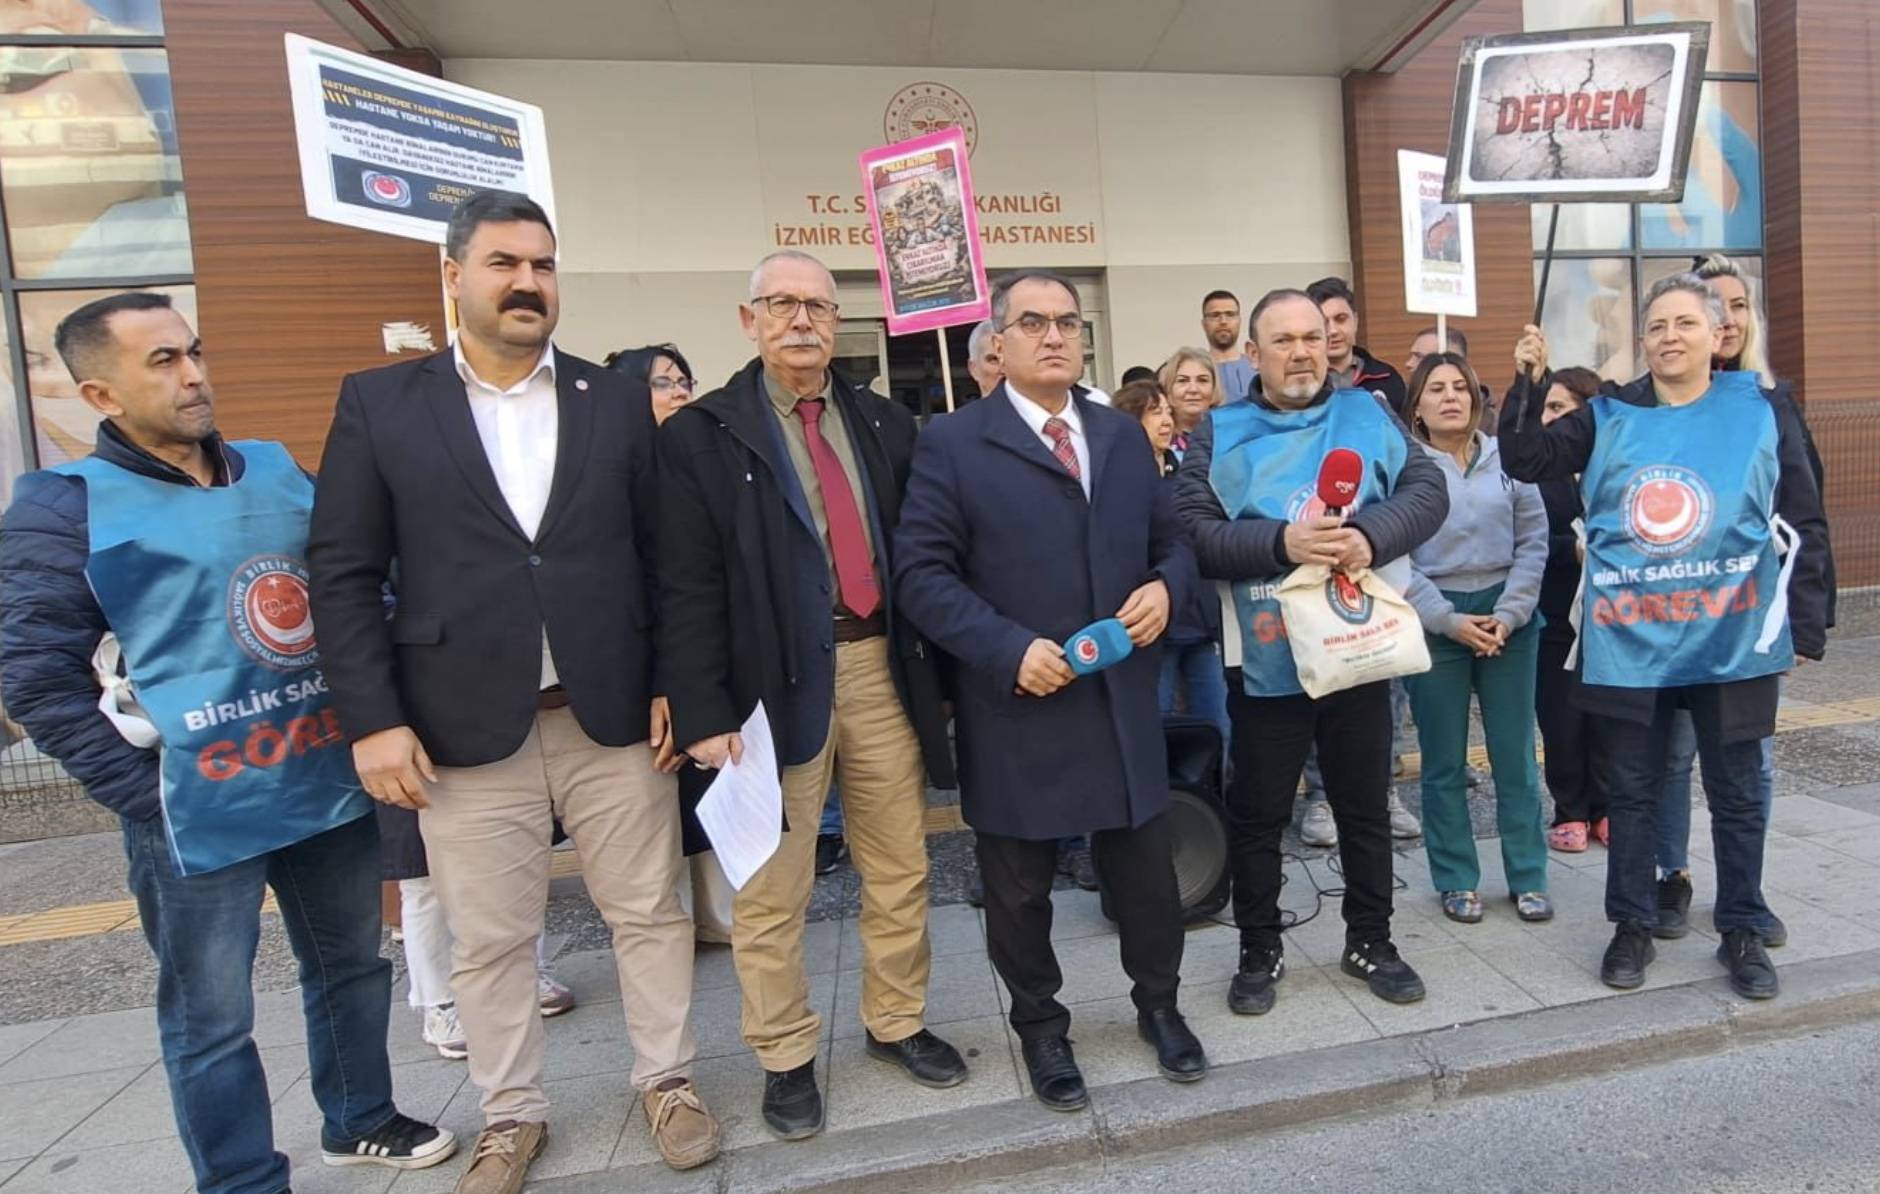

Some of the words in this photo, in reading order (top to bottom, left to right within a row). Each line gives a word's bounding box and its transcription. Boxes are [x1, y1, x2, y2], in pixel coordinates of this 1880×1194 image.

[1496, 87, 1647, 135] DEPREM
[808, 195, 848, 213] T.C.
[975, 192, 1061, 213] KANLIĞI
[776, 223, 841, 245] İZMİR
[1593, 566, 1641, 586] BİRLİK
[1645, 559, 1720, 582] SAĞLIK
[183, 689, 282, 732] BİRLİK
